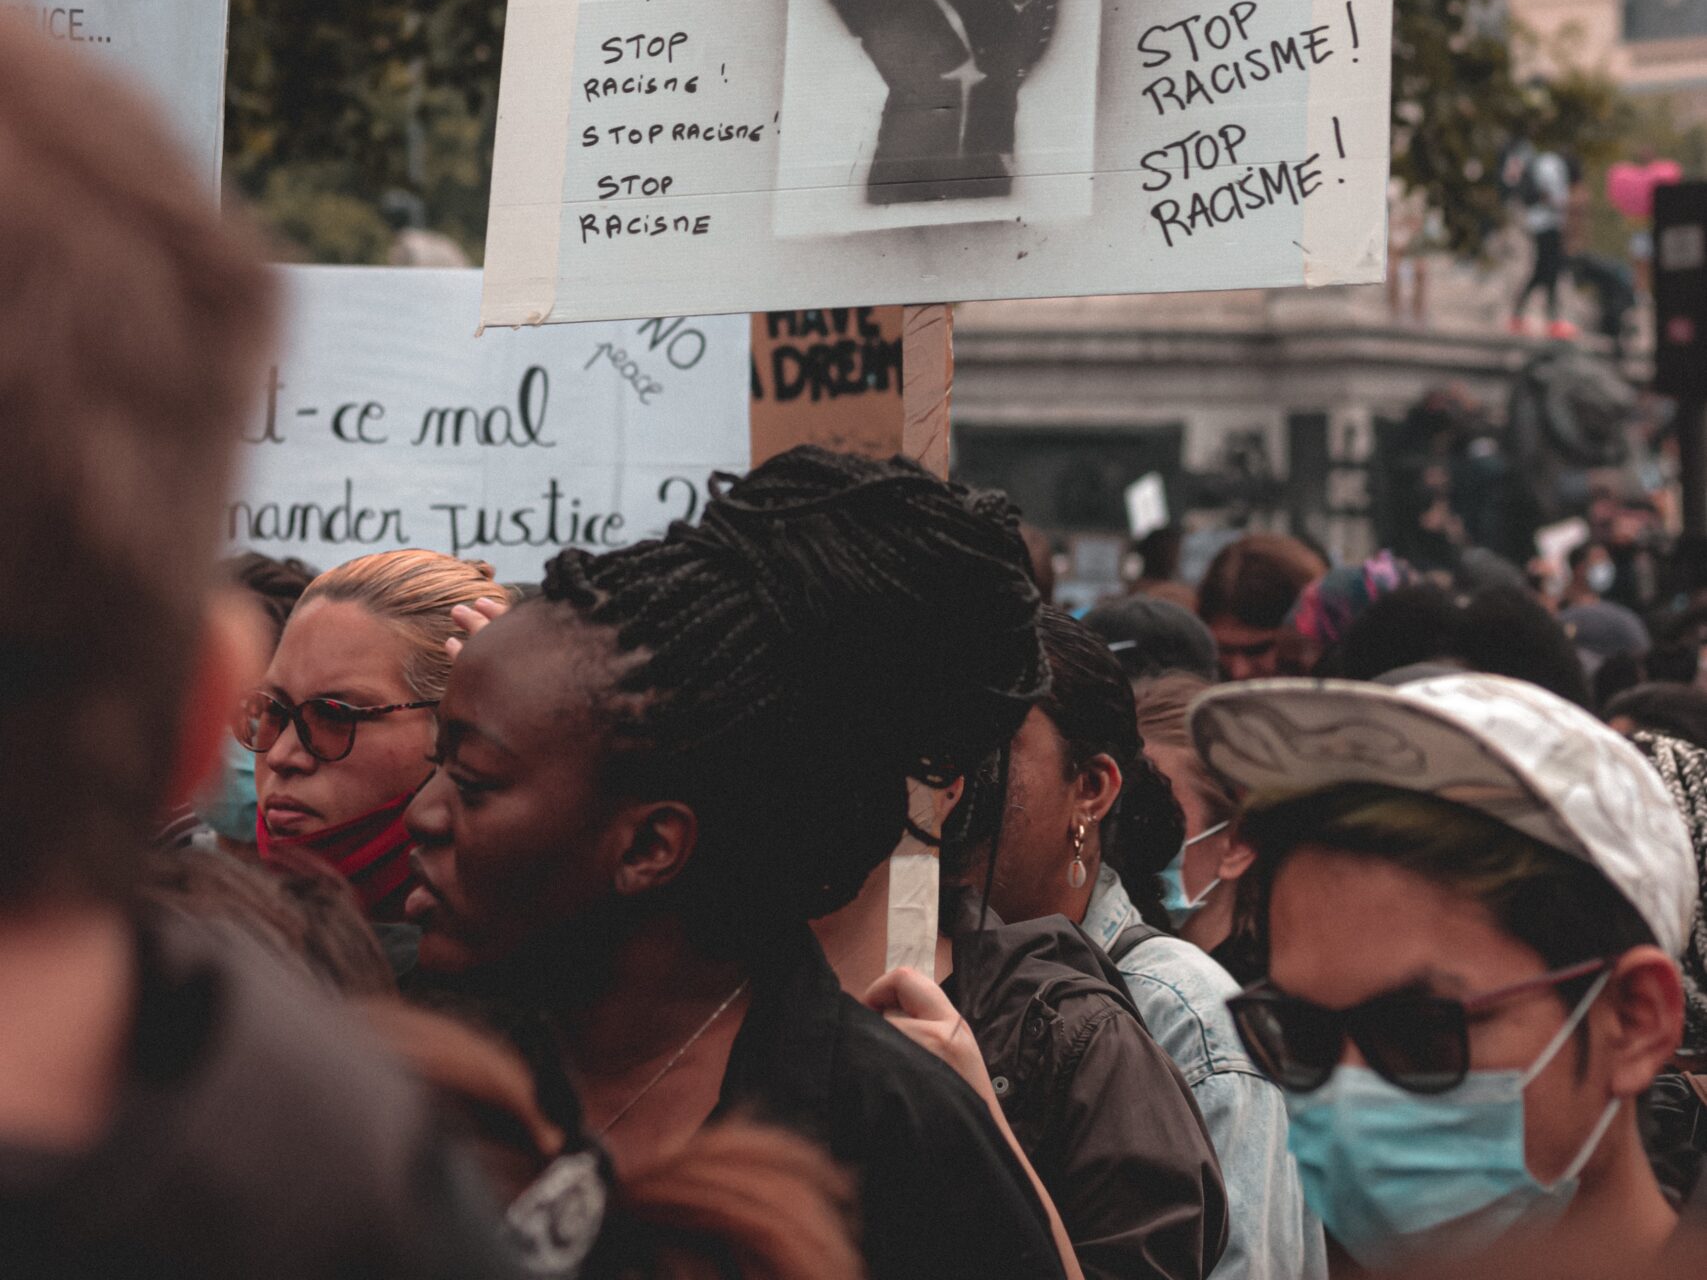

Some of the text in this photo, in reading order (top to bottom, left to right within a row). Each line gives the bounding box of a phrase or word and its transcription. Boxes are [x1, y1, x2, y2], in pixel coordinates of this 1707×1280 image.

[41, 6, 112, 44] ICE...
[600, 31, 689, 64] STOP
[1137, 0, 1258, 69] STOP
[581, 123, 665, 148] STOP
[1139, 123, 1247, 192] STOP
[597, 174, 674, 201] STOP
[636, 316, 707, 370] NO
[584, 340, 664, 406] peace
[410, 364, 557, 449] mal
